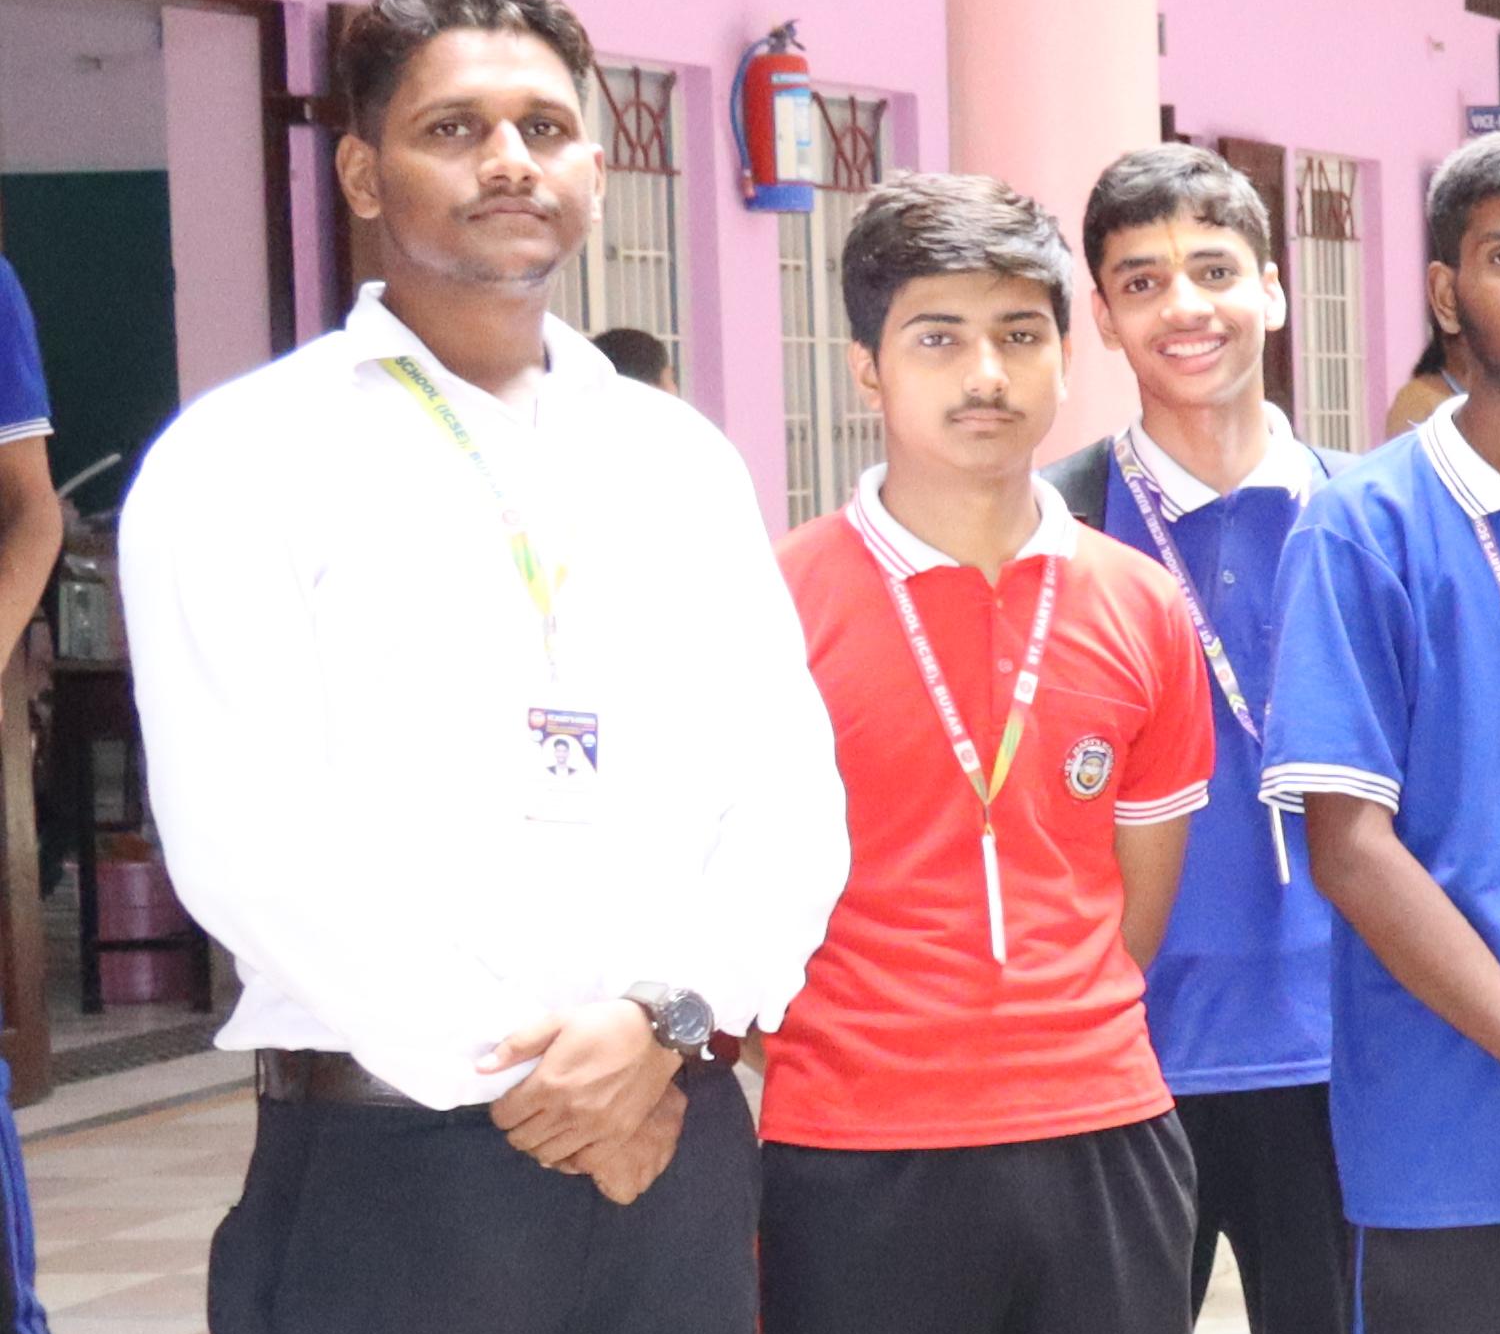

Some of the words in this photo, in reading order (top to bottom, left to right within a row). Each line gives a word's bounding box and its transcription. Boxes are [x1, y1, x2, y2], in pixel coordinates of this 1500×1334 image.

[393, 350, 442, 403] SCHOOL
[432, 400, 474, 451] (ICSE),
[1033, 587, 1053, 639] MARY'S
[887, 574, 921, 634] SCHOOL
[911, 634, 942, 684] (ICSE),
[933, 683, 964, 737] BUXAR
[1026, 643, 1042, 665] ST.
